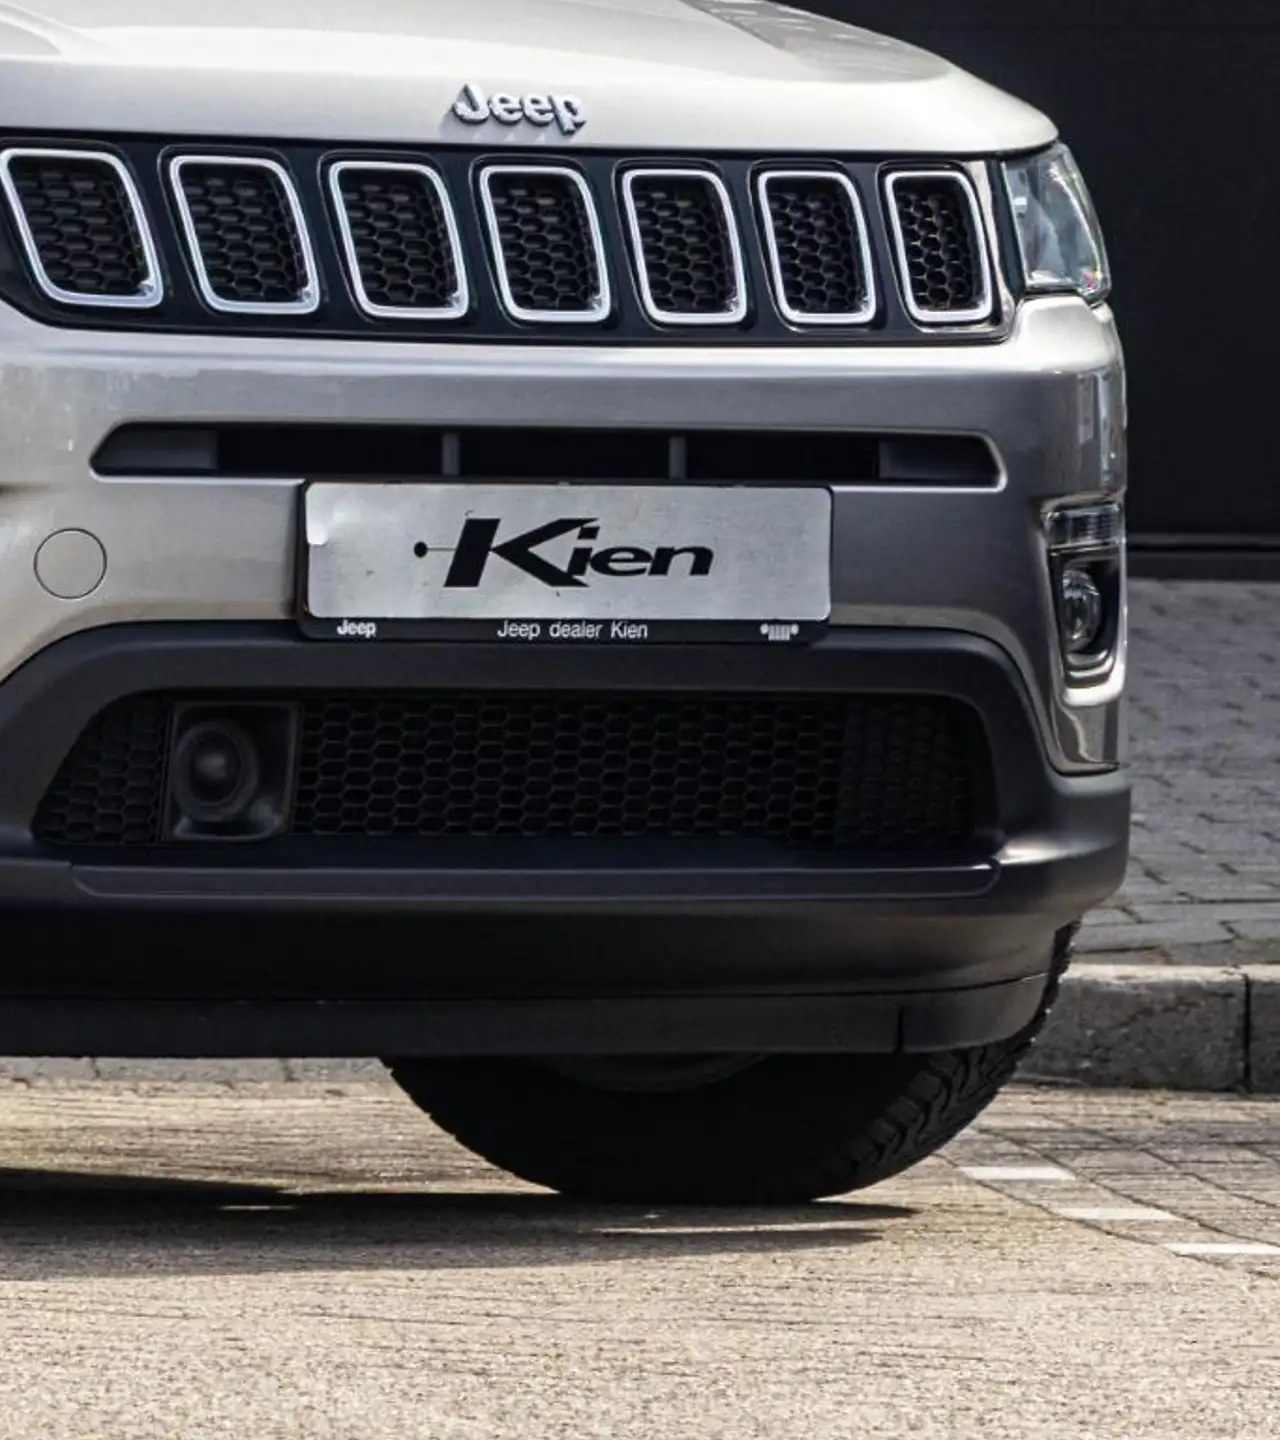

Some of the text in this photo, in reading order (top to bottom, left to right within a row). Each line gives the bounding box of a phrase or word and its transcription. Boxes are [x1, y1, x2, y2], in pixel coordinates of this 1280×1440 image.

[451, 83, 588, 136] Jeep
[443, 517, 715, 588] Kien
[336, 619, 378, 639] Jeep
[497, 620, 649, 641] Jeep dealer Kien
